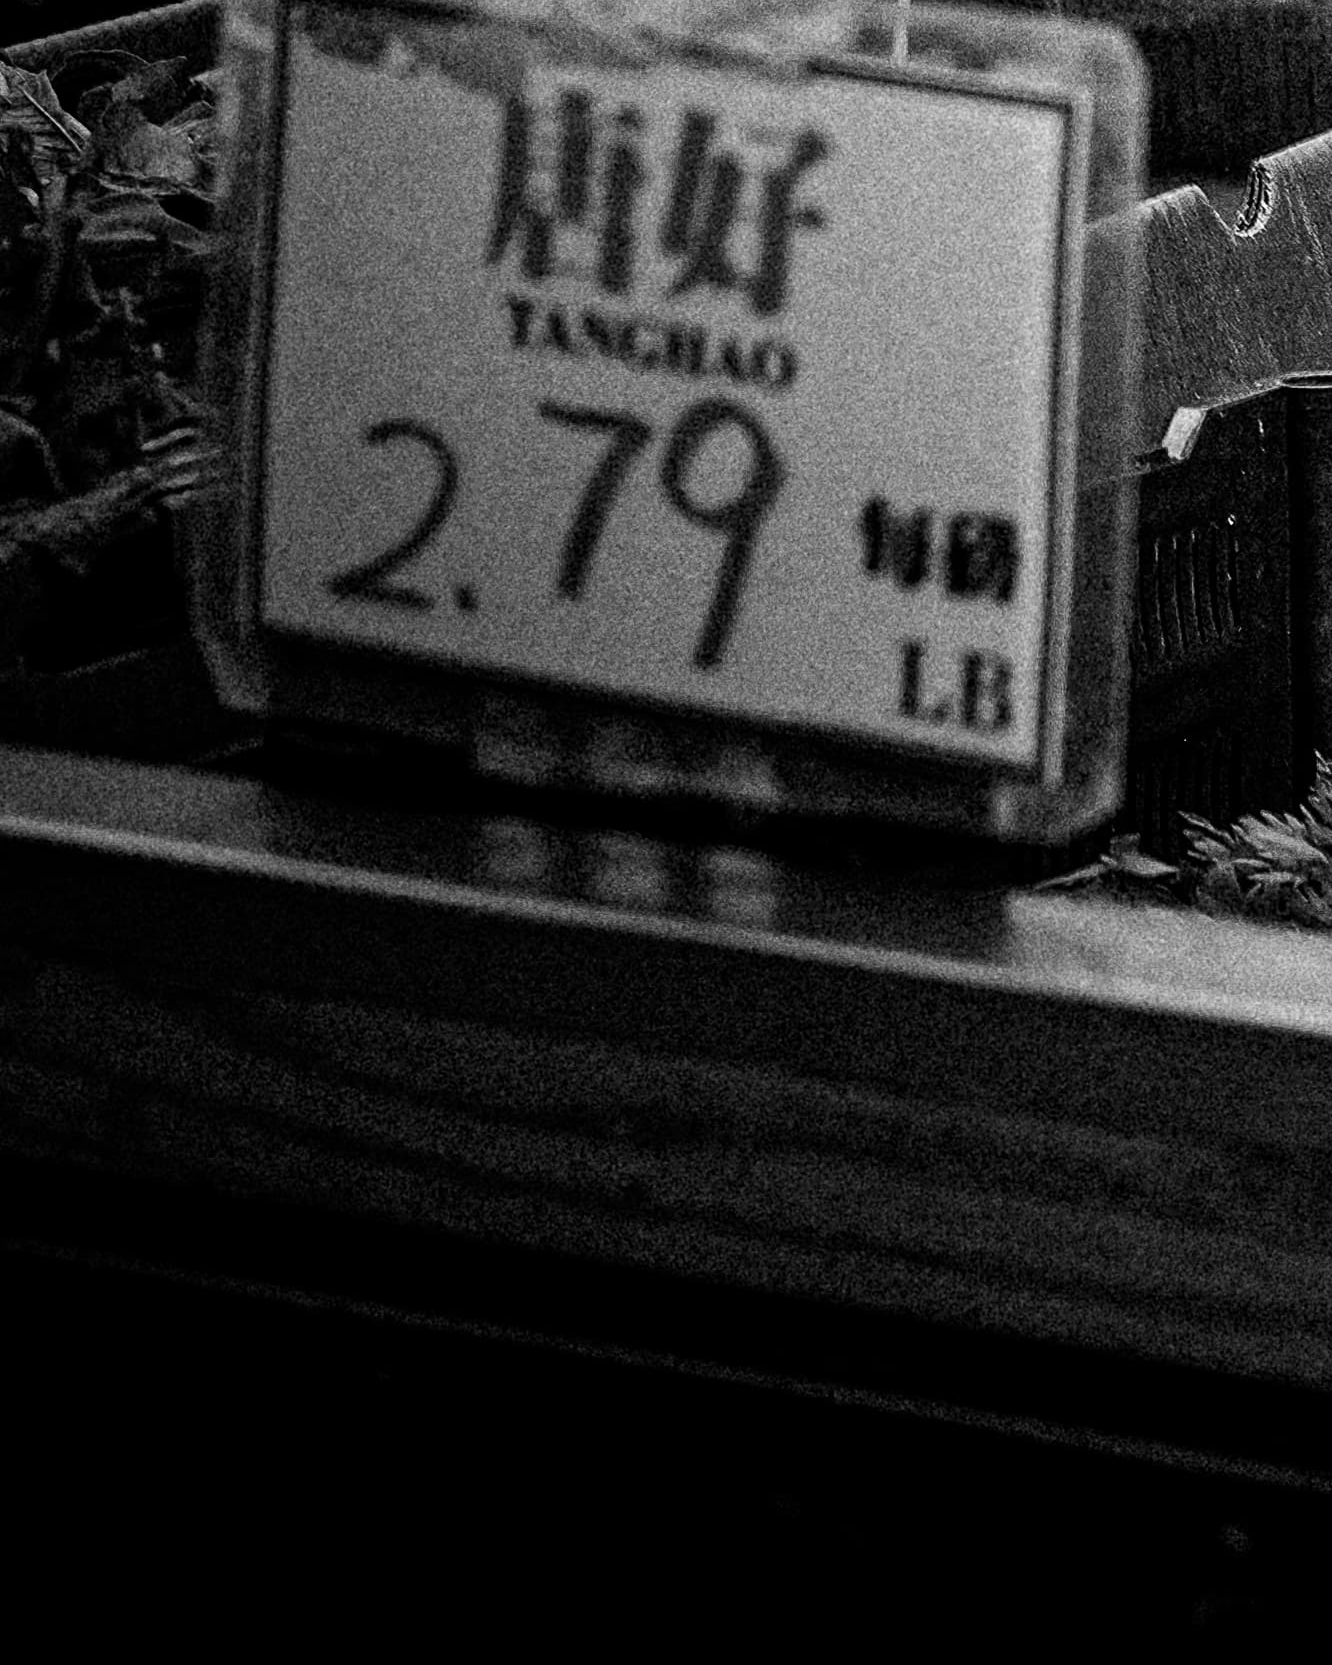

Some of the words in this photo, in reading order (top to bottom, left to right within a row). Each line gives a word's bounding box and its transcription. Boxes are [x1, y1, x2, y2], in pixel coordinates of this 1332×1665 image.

[503, 294, 802, 394] TANGHAO
[326, 396, 790, 671] 2.79
[899, 638, 1013, 733] LB
